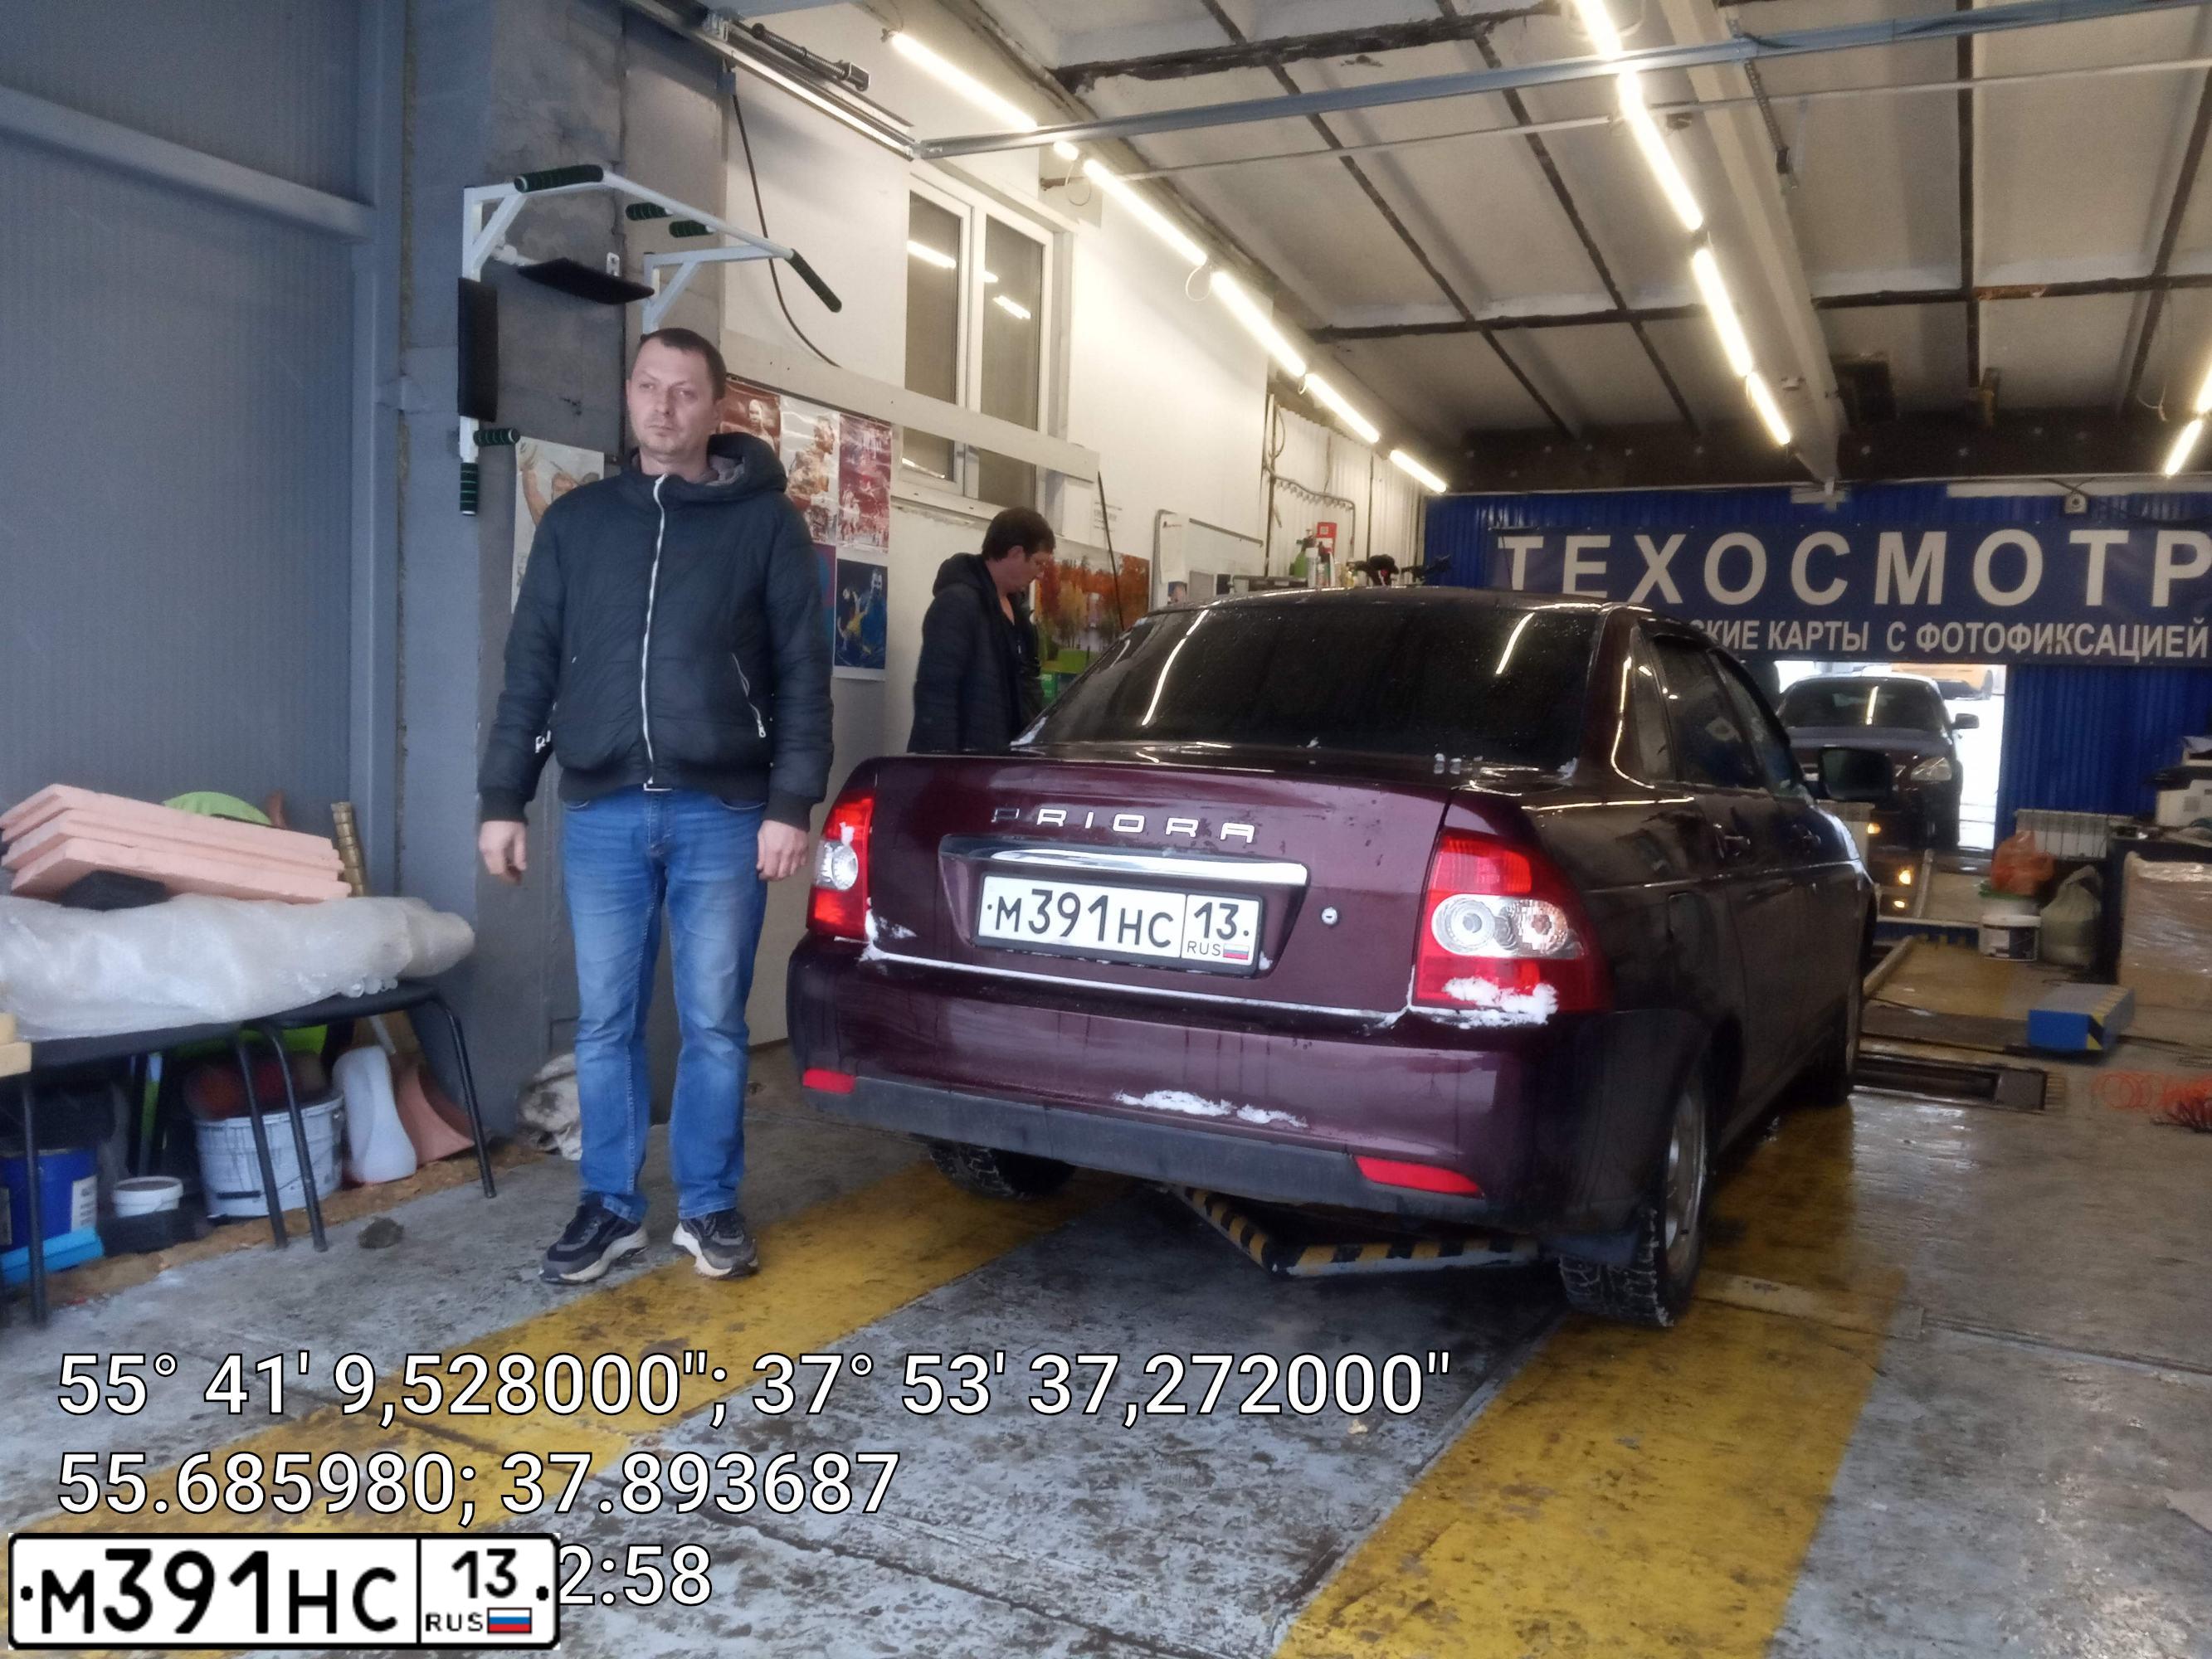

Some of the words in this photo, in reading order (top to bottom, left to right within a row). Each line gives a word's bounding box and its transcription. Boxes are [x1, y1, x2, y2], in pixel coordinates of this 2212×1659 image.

[1497, 528, 2212, 608] ТЕХОСМОТР
[1768, 620, 1869, 652] КАРТЫ
[1886, 620, 1907, 653] С
[1915, 617, 2210, 663] ФОТОФИКСАЦИЕЙ
[991, 807, 1255, 844] PRIORA
[995, 888, 1175, 949] М391НС
[1194, 902, 1238, 940] 13
[1186, 941, 1221, 957] RUS
